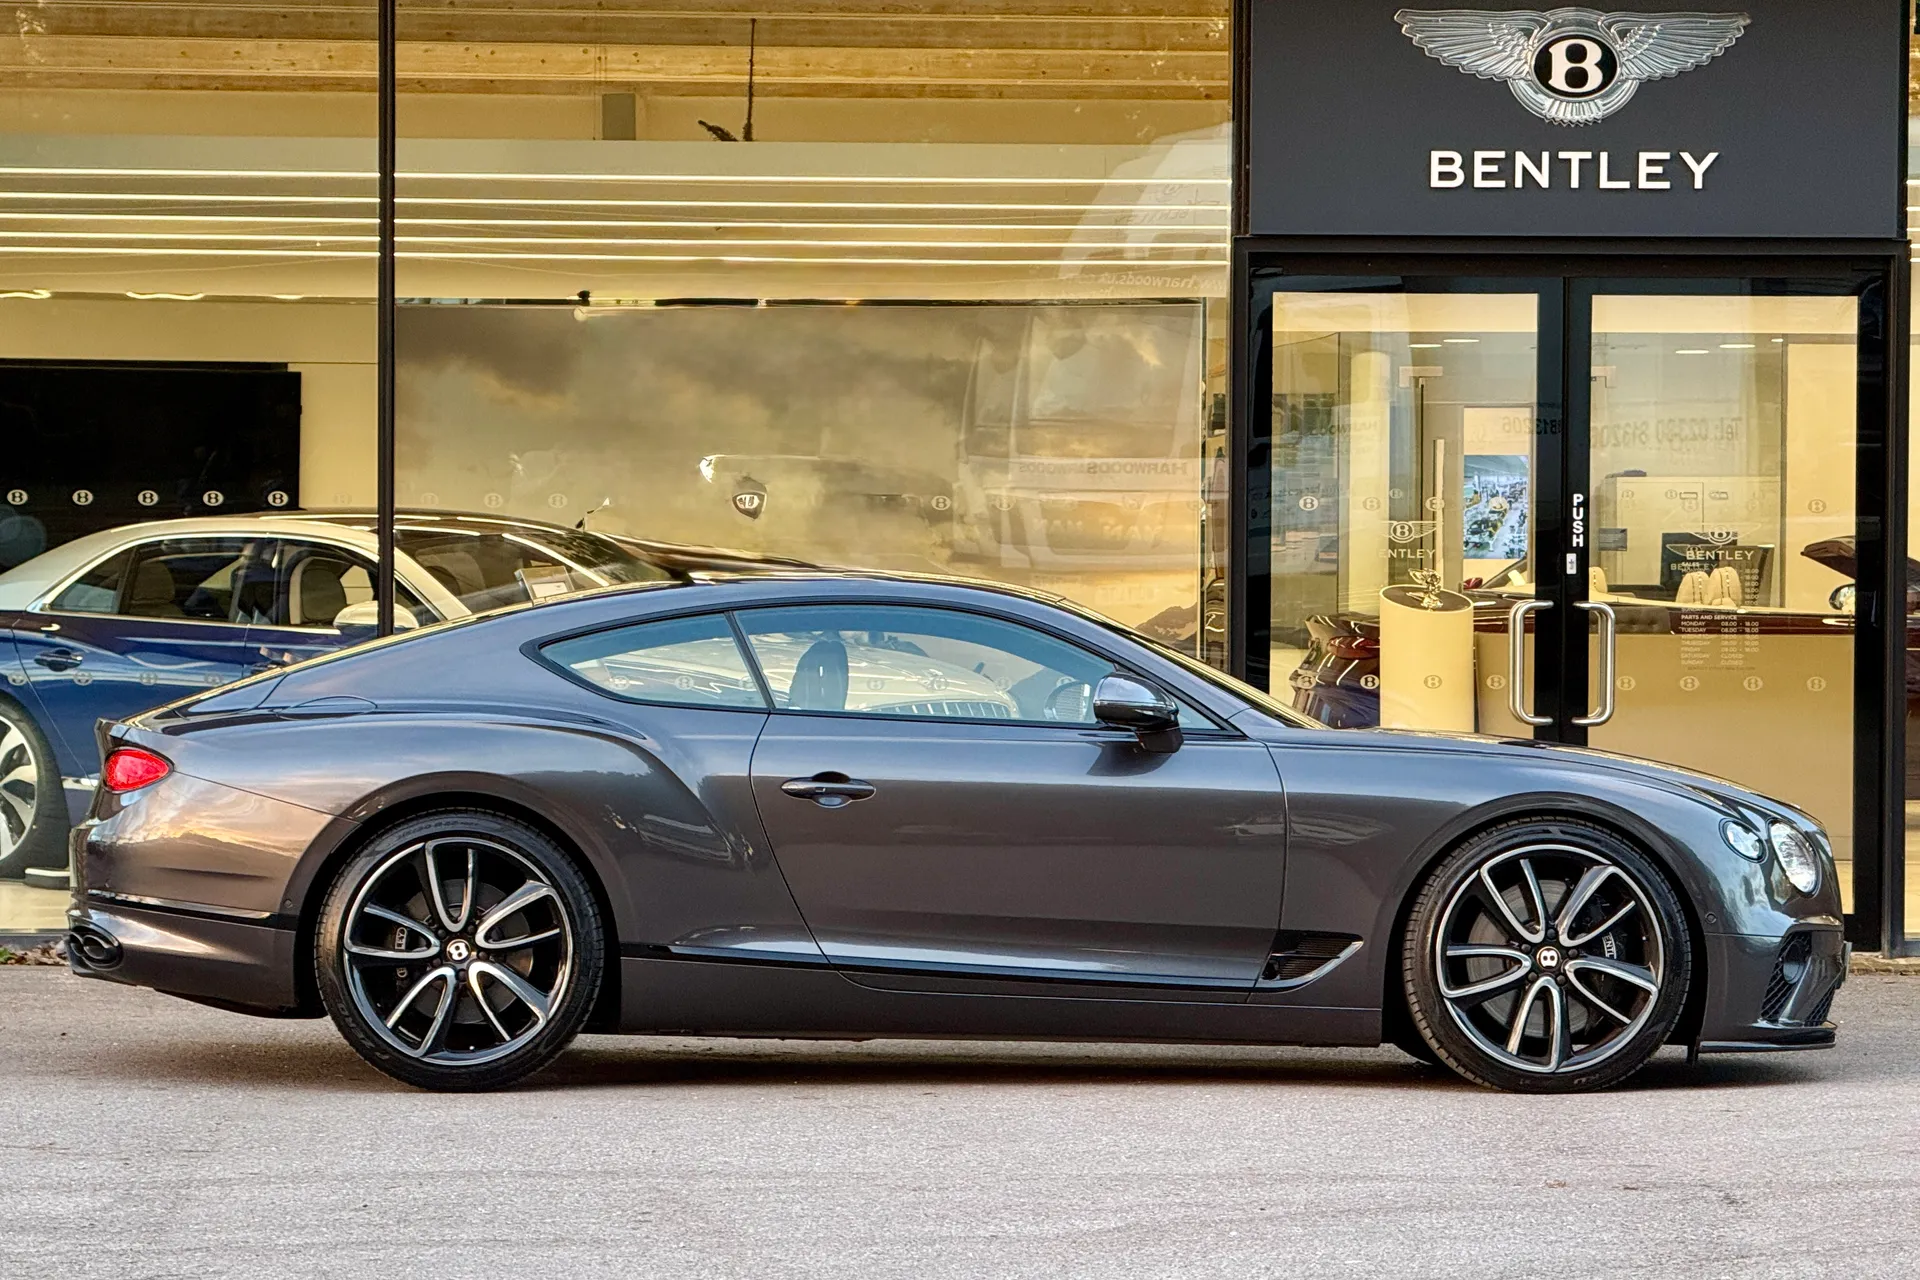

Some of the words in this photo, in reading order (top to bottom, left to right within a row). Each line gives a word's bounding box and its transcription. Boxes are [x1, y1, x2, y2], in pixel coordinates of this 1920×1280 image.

[1548, 39, 1603, 93] B
[1430, 150, 1720, 190] BENTLEY
[1572, 493, 1584, 548] PUSH
[1380, 549, 1436, 559] ENTLEY
[1686, 550, 1755, 561] BENTLEY
[449, 942, 469, 961] B
[1540, 949, 1559, 968] B
